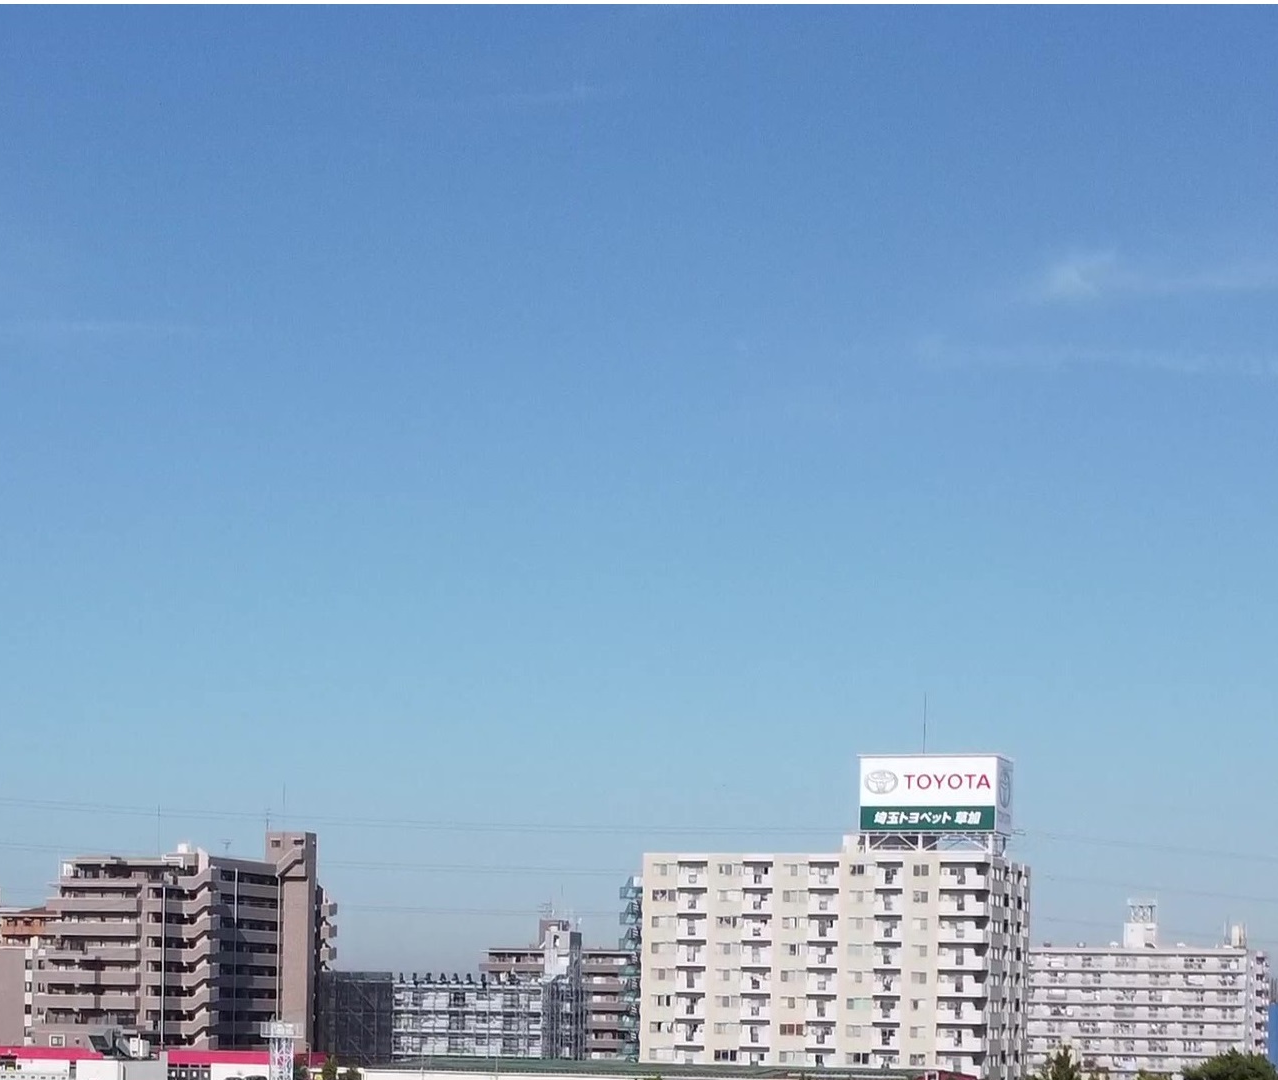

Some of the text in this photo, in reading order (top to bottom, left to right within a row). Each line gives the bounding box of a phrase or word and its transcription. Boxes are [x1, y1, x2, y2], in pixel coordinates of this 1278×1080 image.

[903, 773, 991, 790] TOYOTA
[873, 811, 952, 825] 埼玉トヨペット
[954, 811, 982, 825] 草加
